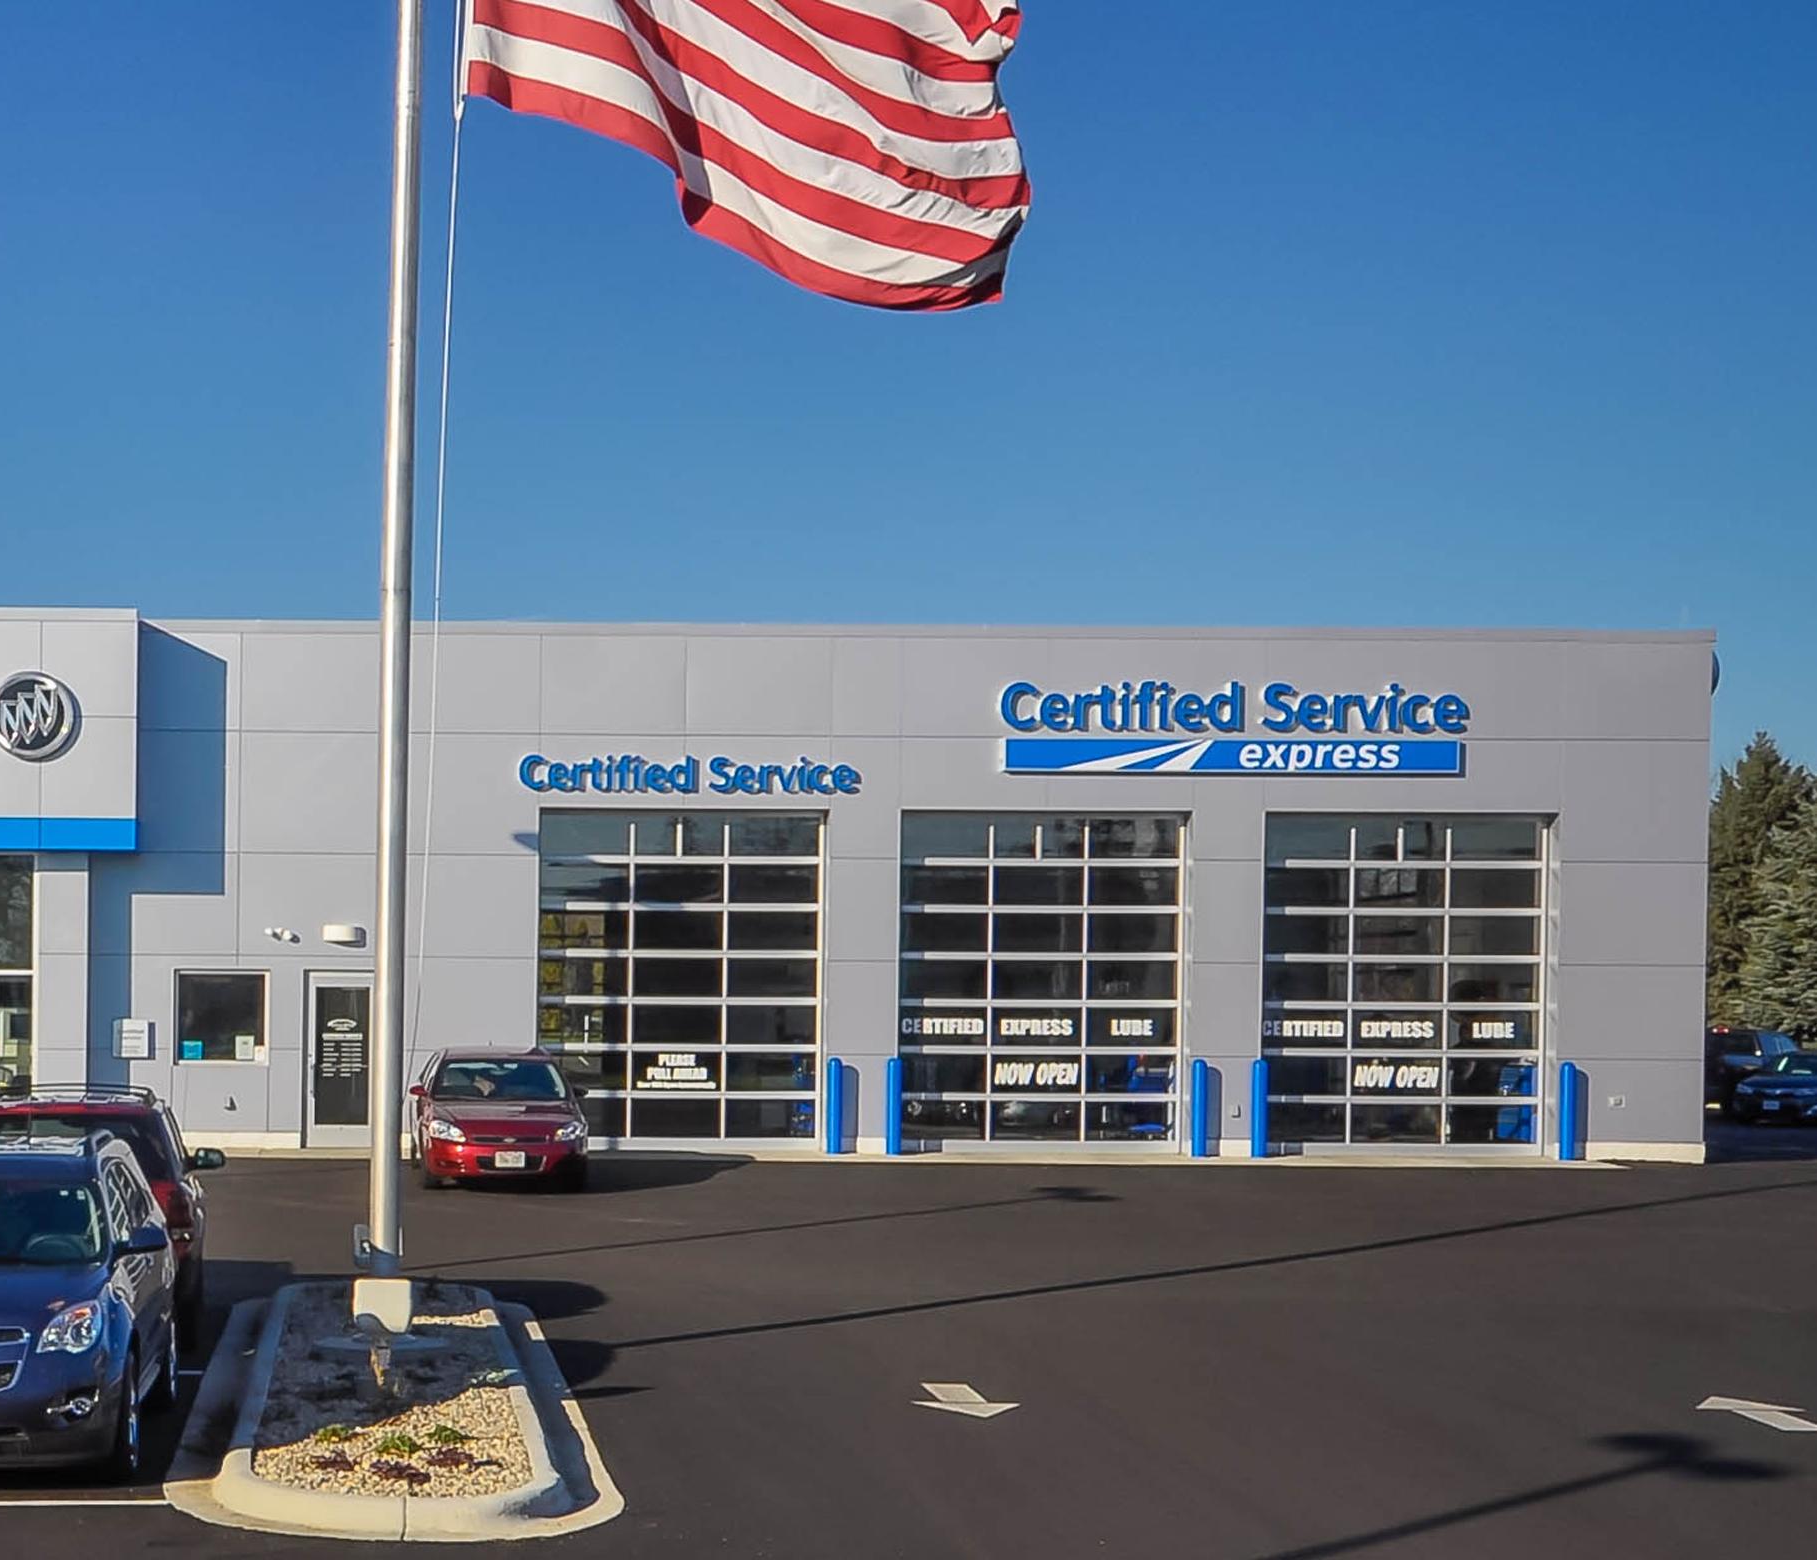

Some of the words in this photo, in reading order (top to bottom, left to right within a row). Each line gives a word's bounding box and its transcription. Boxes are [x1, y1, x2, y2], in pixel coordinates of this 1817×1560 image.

[1000, 680, 1243, 733] Certified
[1262, 682, 1470, 734] Service
[1238, 740, 1401, 771] express
[519, 754, 699, 795] Certified
[708, 756, 862, 795] Service
[901, 1017, 984, 1036] CERTIFIED
[1000, 1018, 1074, 1037] EXPRESS
[1110, 1018, 1154, 1037] LUBE
[1262, 1019, 1345, 1038] CERTIFIED
[1360, 1020, 1435, 1039] EXPRESS
[1471, 1021, 1515, 1039] LUBE
[993, 1062, 1035, 1086] NOW
[1035, 1062, 1079, 1086] OPEN
[1353, 1064, 1396, 1088] NOW
[1395, 1065, 1441, 1089] OPEN
